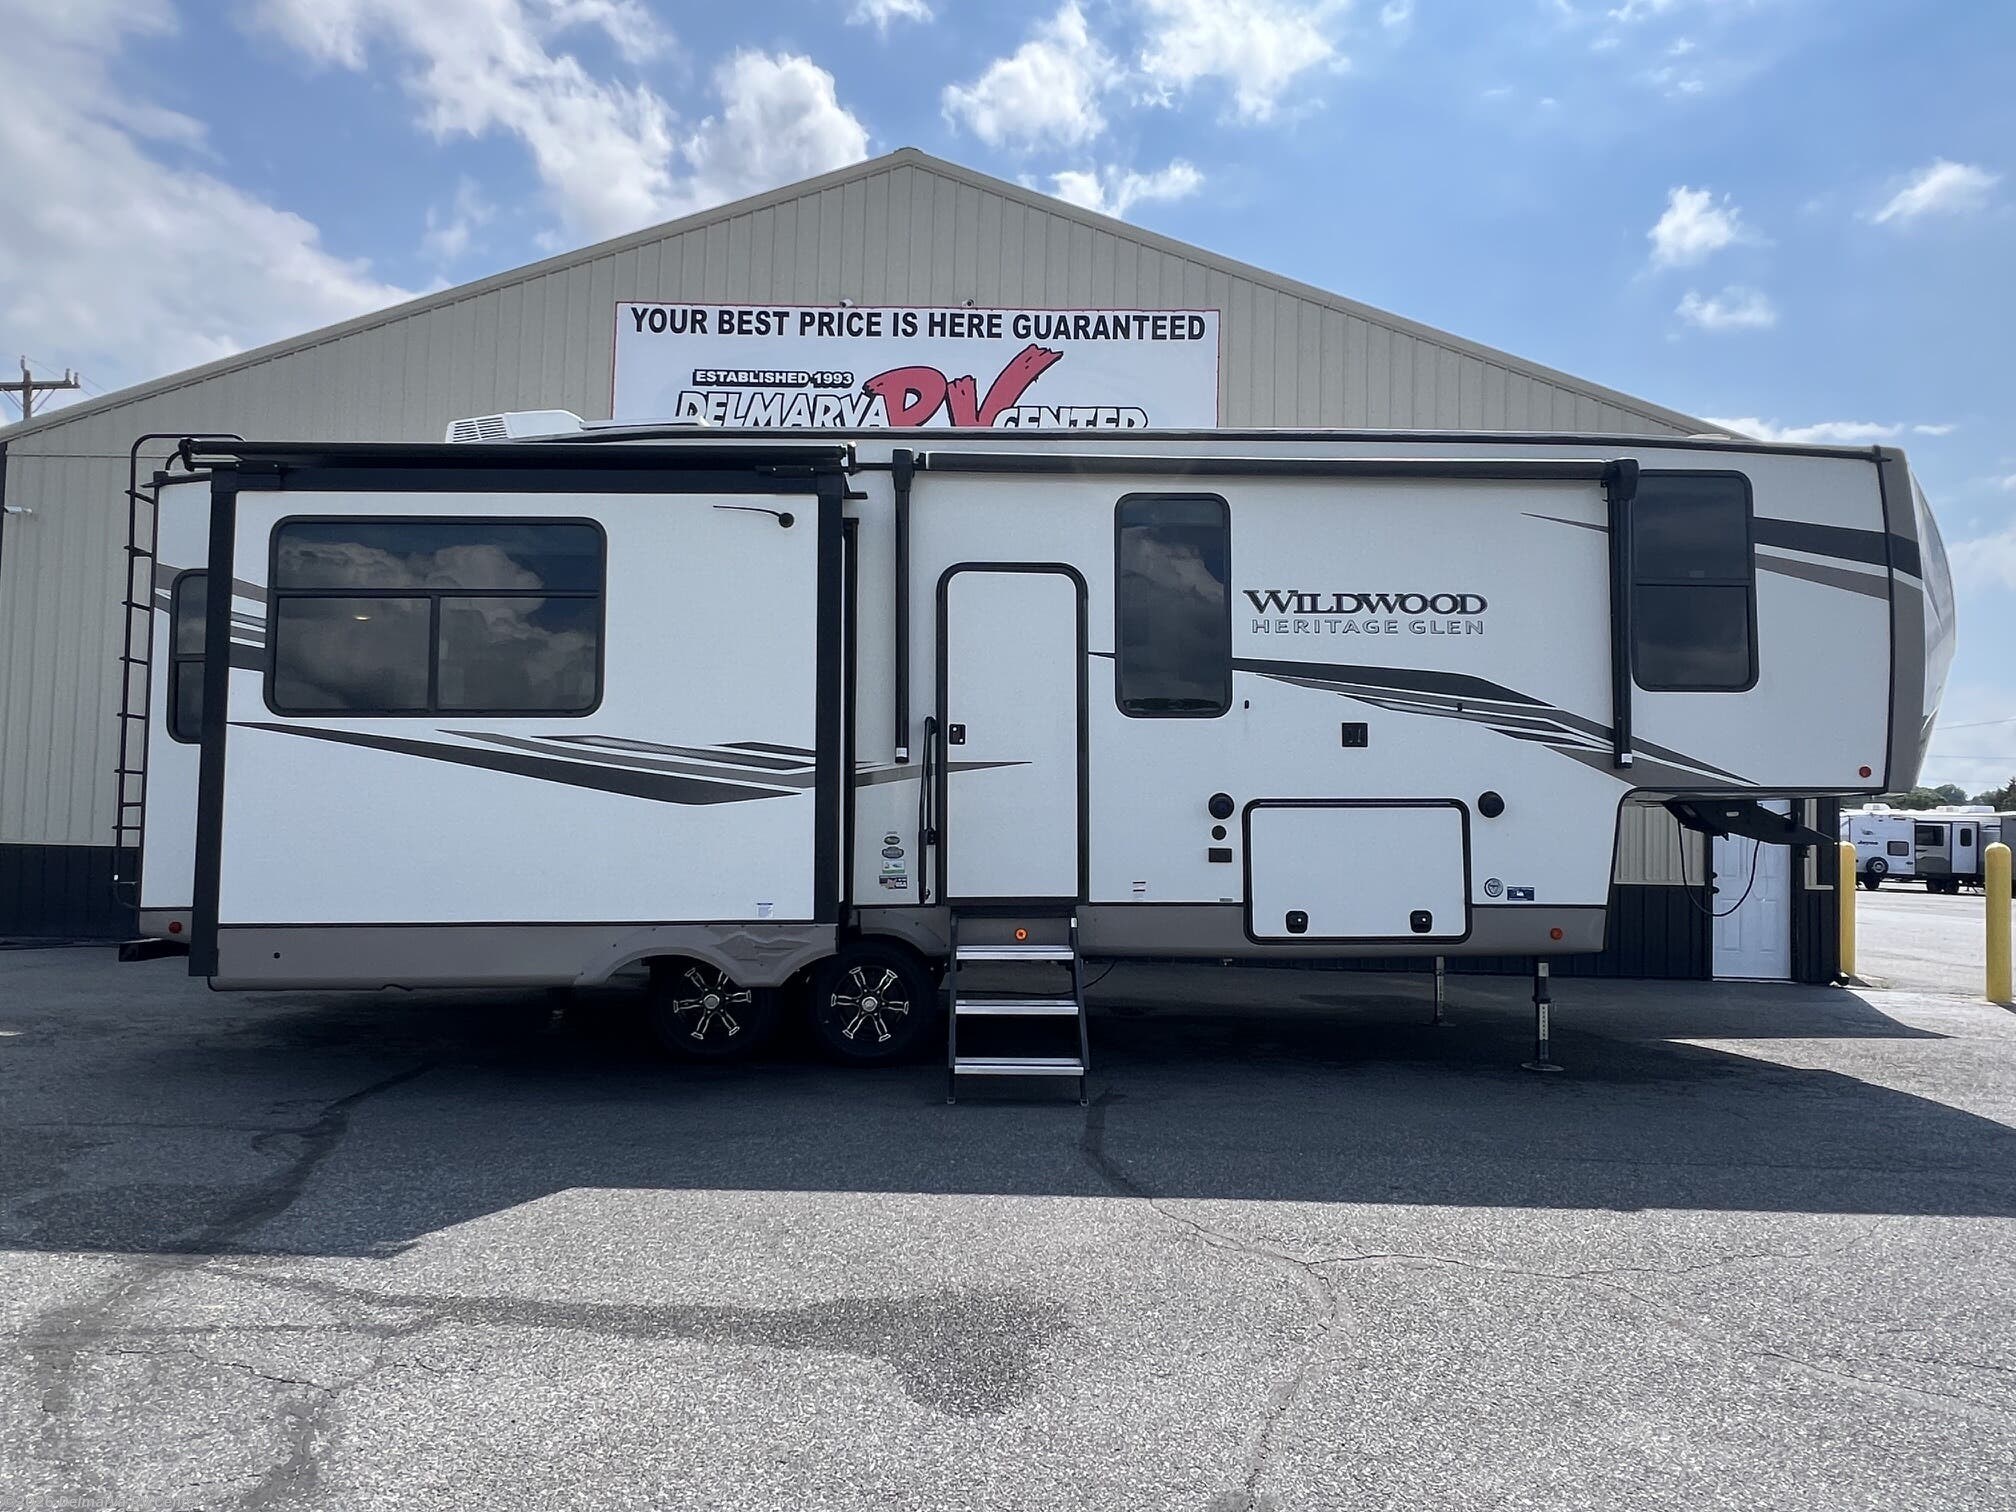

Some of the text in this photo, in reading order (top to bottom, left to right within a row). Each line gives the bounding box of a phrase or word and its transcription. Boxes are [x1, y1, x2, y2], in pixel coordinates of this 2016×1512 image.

[631, 307, 1205, 340] YOUR BEST PRICE IS HERE GUARANTEED
[676, 391, 892, 427] DELMARVA
[862, 344, 1064, 427] RV
[696, 371, 853, 385] ESTABLISHED 1993
[1242, 589, 1488, 614] WILDWOOD
[1251, 618, 1484, 635] HERITAGE GLEN
